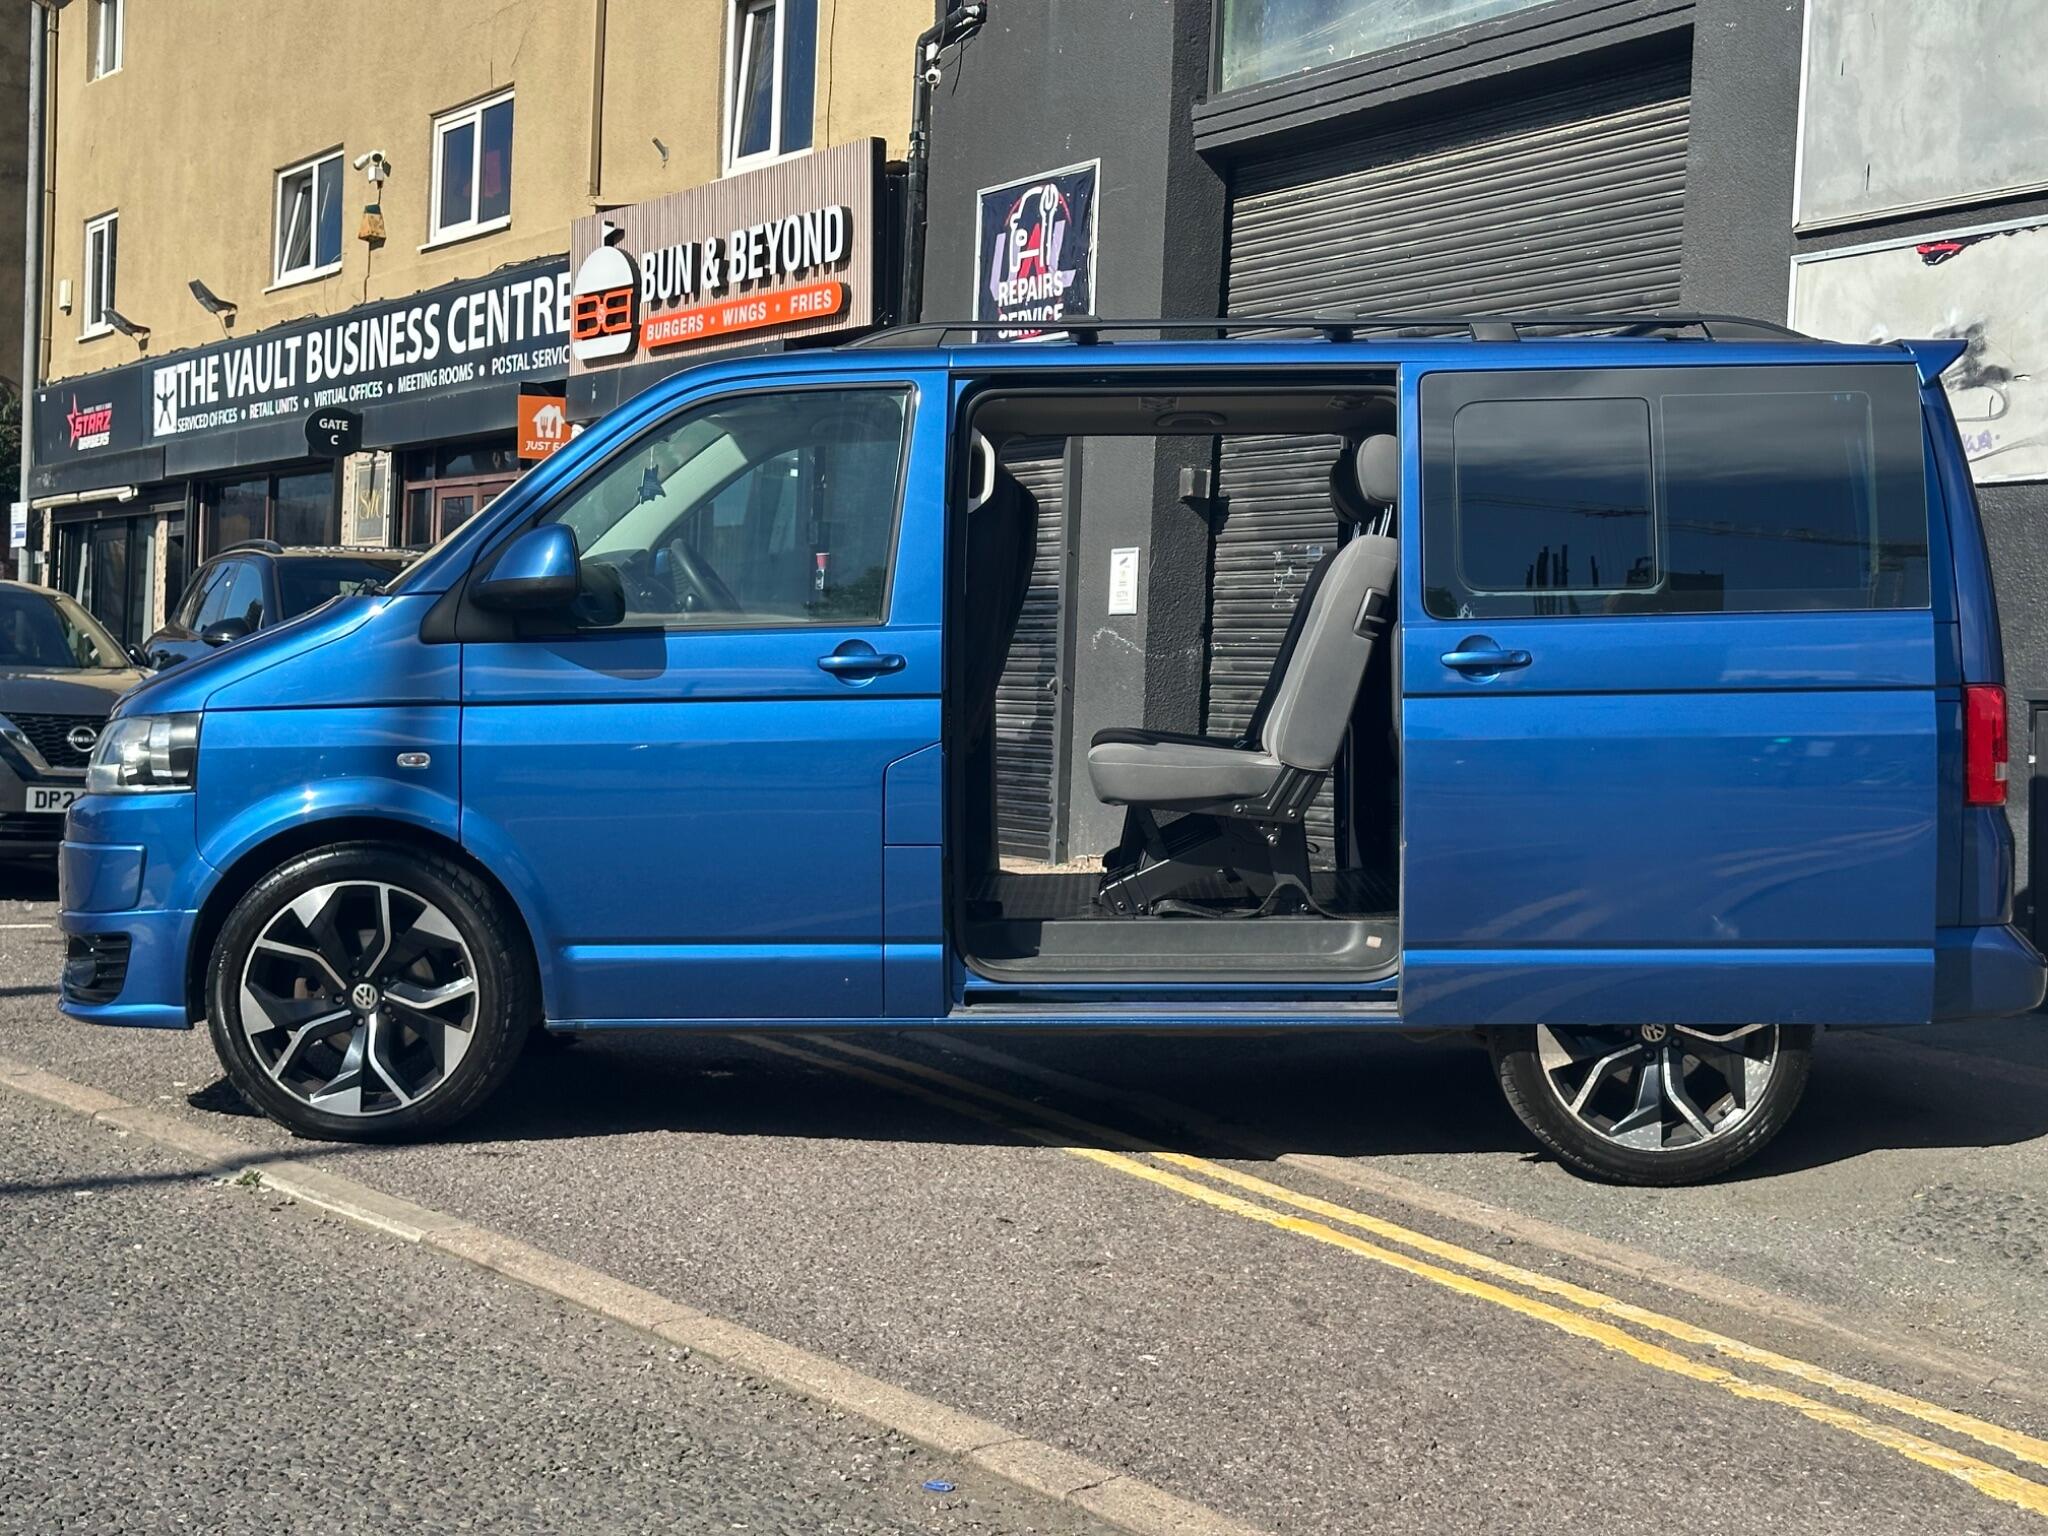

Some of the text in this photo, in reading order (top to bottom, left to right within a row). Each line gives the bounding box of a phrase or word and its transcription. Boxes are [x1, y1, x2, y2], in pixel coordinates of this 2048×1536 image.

[641, 204, 844, 303] BUN & BEYOND
[998, 271, 1064, 307] REPAIRS
[646, 288, 832, 341] BURGERS WINGS FRIES
[177, 271, 571, 409] THE VAULT BUSINESS CENTRE
[177, 344, 570, 433] SERVICED OFFICES RETAIL UNITS VIRTUAL OFFICES MEETING ROOMS POSTAL SERVIC
[74, 410, 112, 438] STARZ
[319, 418, 349, 431] GATE
[330, 435, 339, 445] C
[525, 440, 551, 451] JUST
[67, 735, 96, 743] NISSA
[35, 790, 76, 809] DP2
